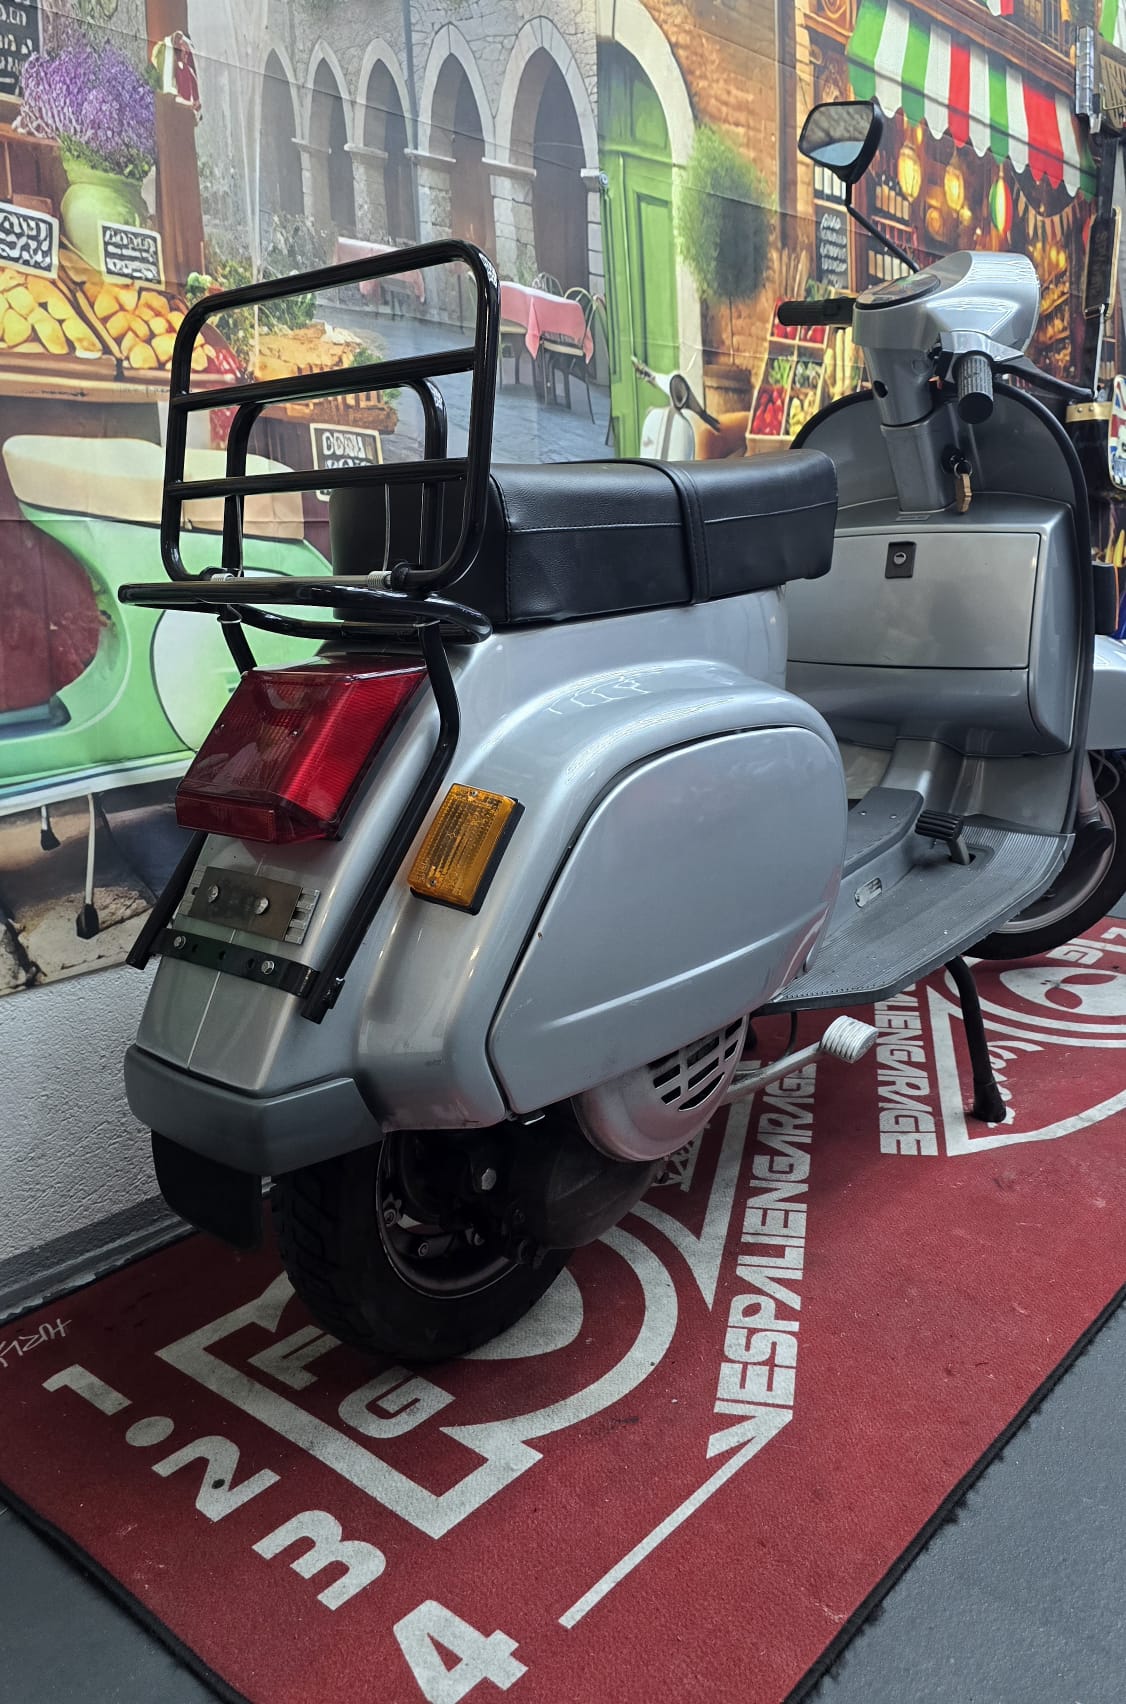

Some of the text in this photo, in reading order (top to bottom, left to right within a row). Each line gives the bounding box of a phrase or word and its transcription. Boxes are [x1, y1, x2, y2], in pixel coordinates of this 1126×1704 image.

[874, 984, 938, 1156] ALIENGARAGE
[338, 1366, 456, 1439] G
[151, 1435, 281, 1523] 2
[393, 1600, 529, 1704] 4
